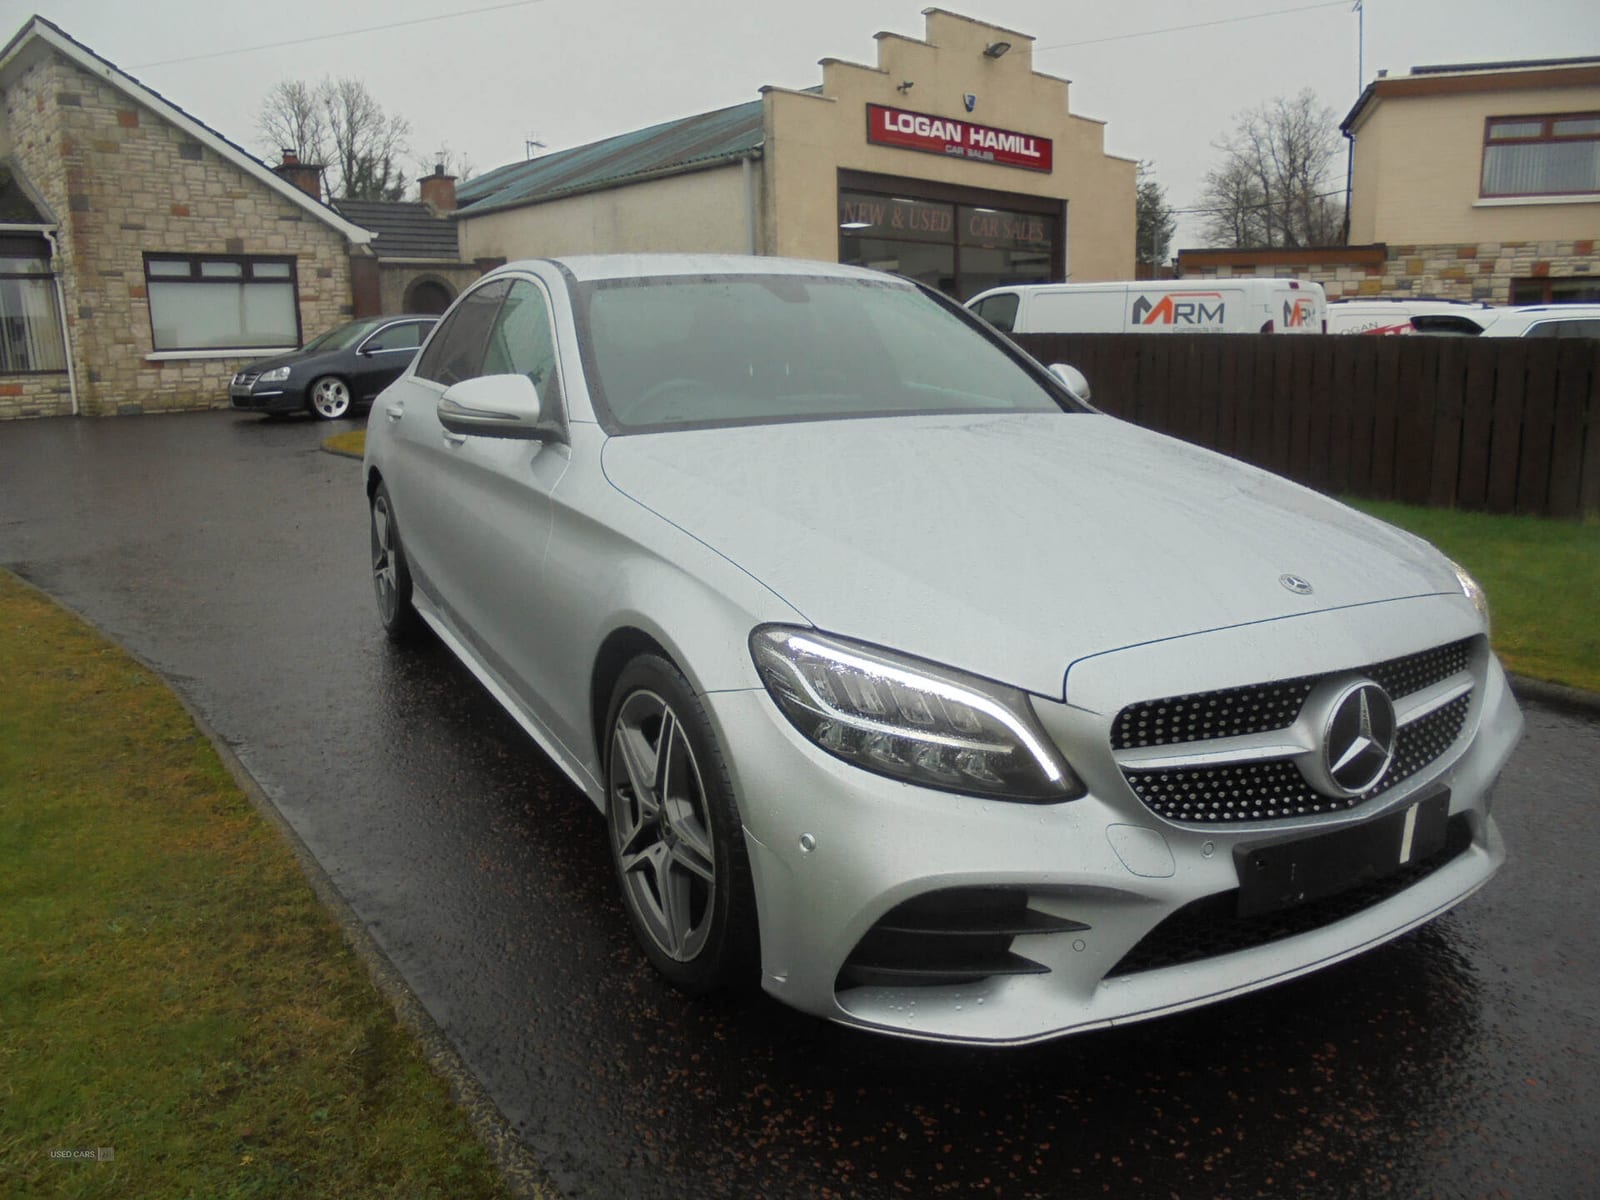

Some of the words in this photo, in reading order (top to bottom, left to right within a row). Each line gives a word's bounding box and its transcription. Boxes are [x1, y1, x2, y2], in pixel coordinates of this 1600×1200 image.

[884, 111, 962, 142] LOGAN
[969, 128, 1041, 158] HAMILL
[945, 144, 964, 154] CAR
[968, 148, 994, 161] SALES
[844, 202, 885, 226] NEW
[891, 207, 905, 229] &
[909, 207, 950, 232] USED
[970, 215, 999, 237] CAR
[1003, 219, 1044, 241] SALES
